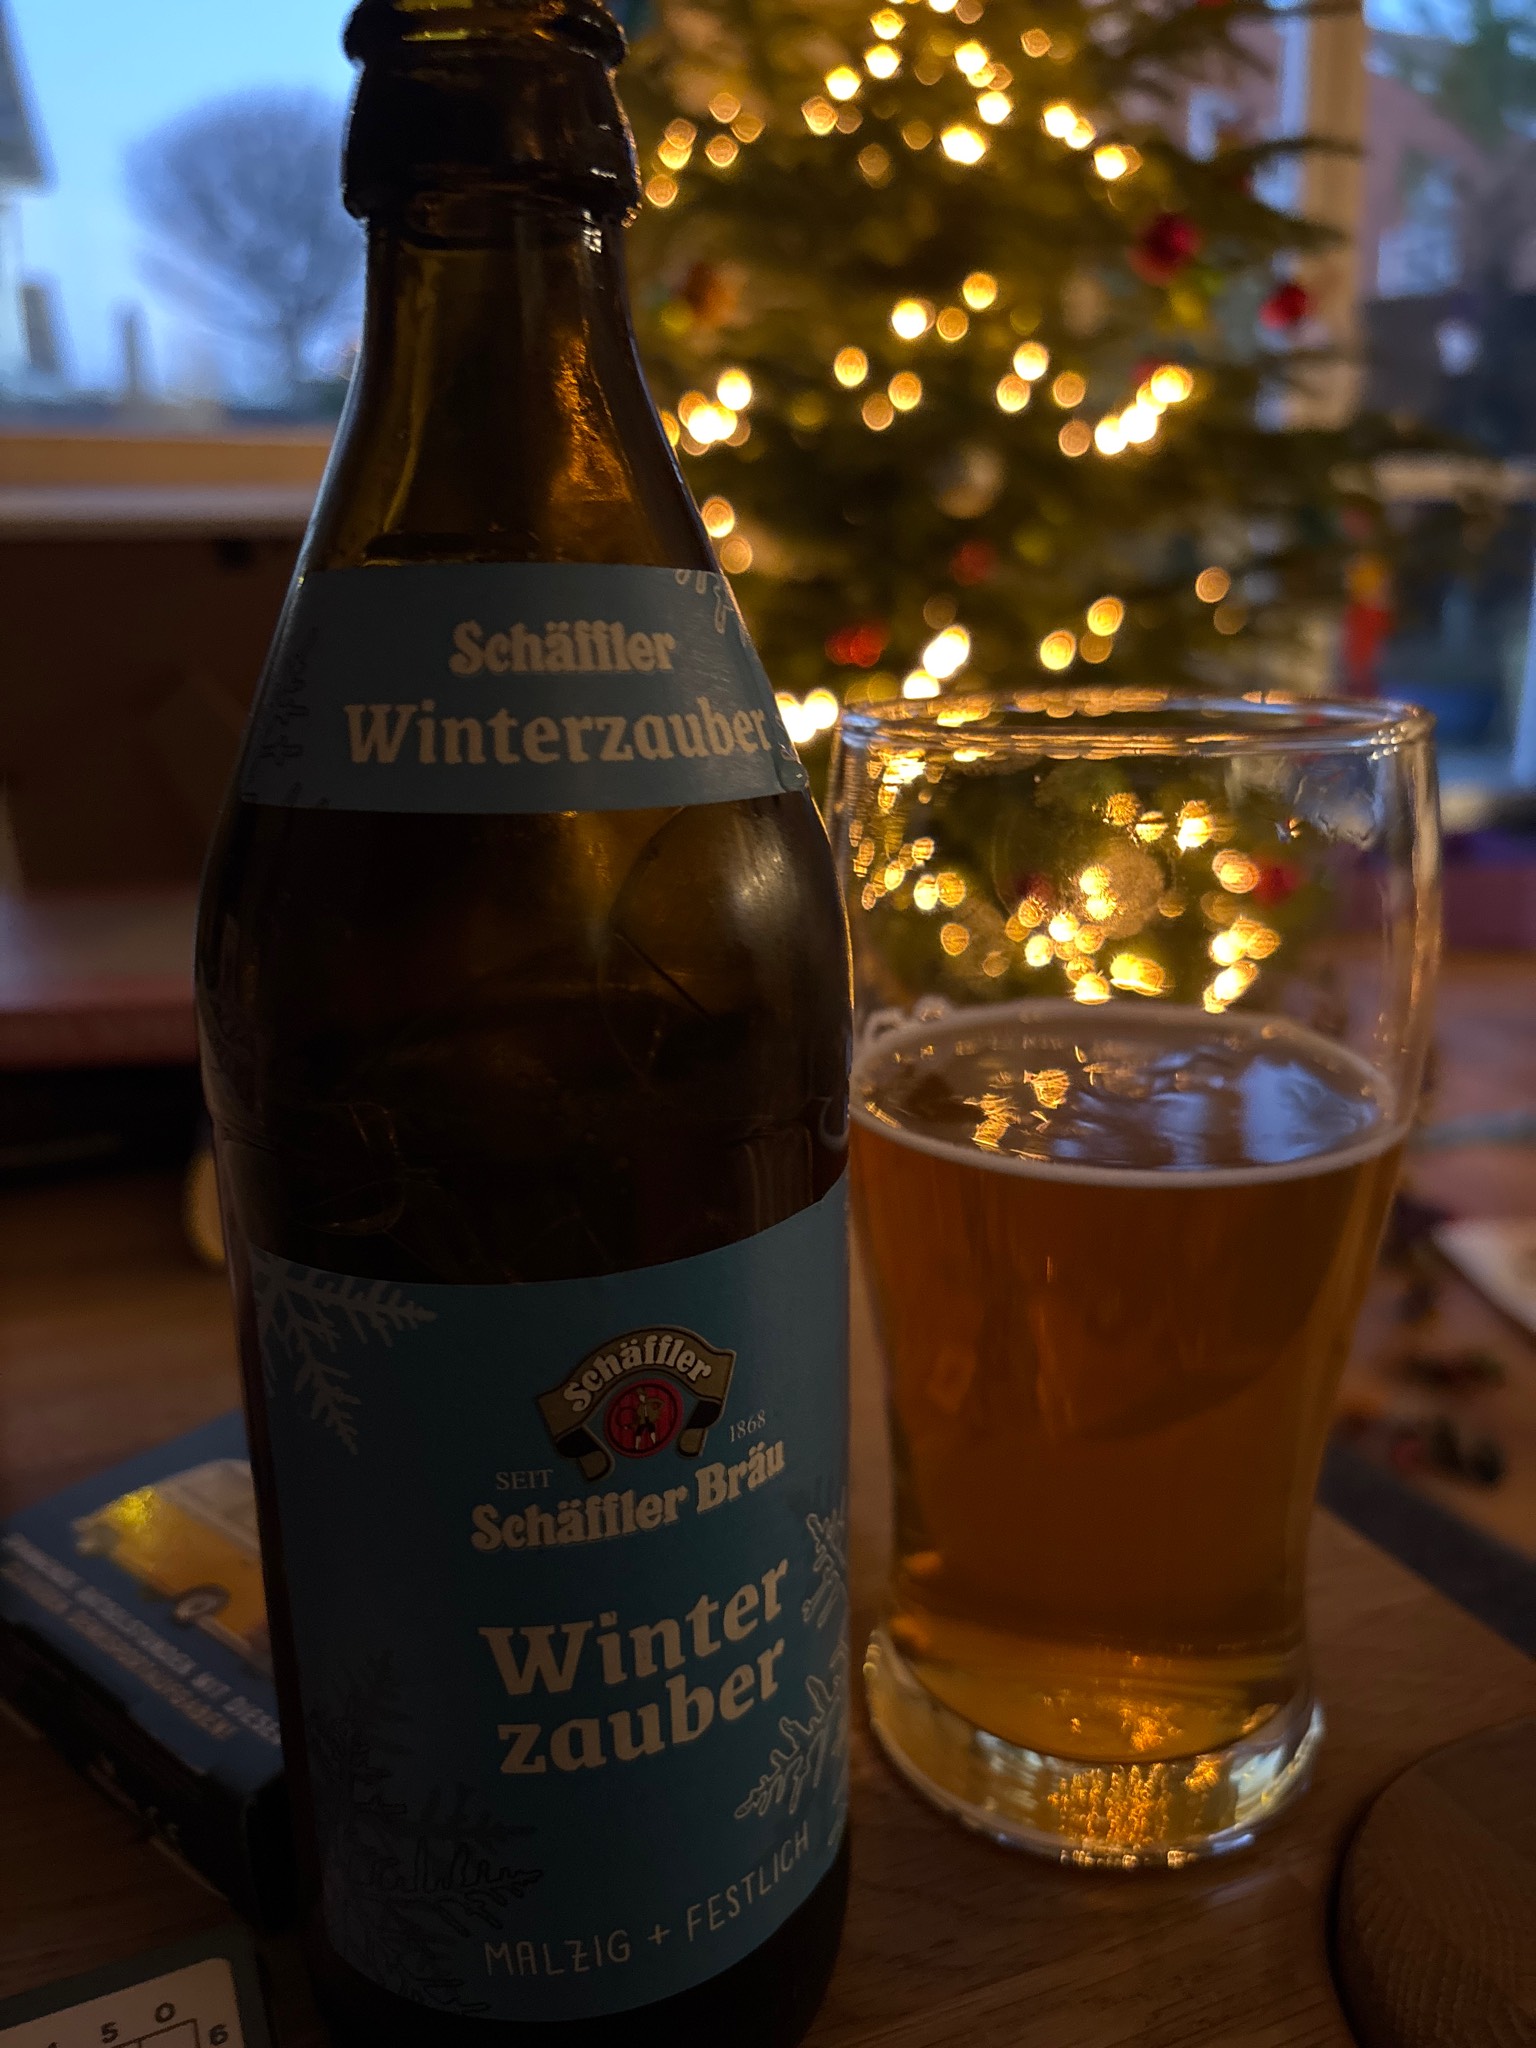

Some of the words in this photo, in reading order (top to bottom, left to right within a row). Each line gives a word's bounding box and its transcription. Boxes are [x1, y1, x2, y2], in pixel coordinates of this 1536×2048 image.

[448, 619, 676, 675] Schäffler
[344, 699, 772, 765] Winterzauber
[563, 1334, 712, 1412] Schäffler
[729, 1410, 767, 1442] 1868
[470, 1485, 689, 1551] Schäffler
[694, 1440, 785, 1514] Bräu
[495, 1469, 553, 1490] SEIT
[478, 1558, 789, 1696] Winter
[497, 1637, 786, 1775] zauber
[483, 1929, 632, 1976] MALZIG
[648, 1924, 670, 1945] +
[686, 1820, 810, 1942] FESTLICH
[102, 2022, 119, 2044] 5
[209, 2024, 229, 2046] 6
